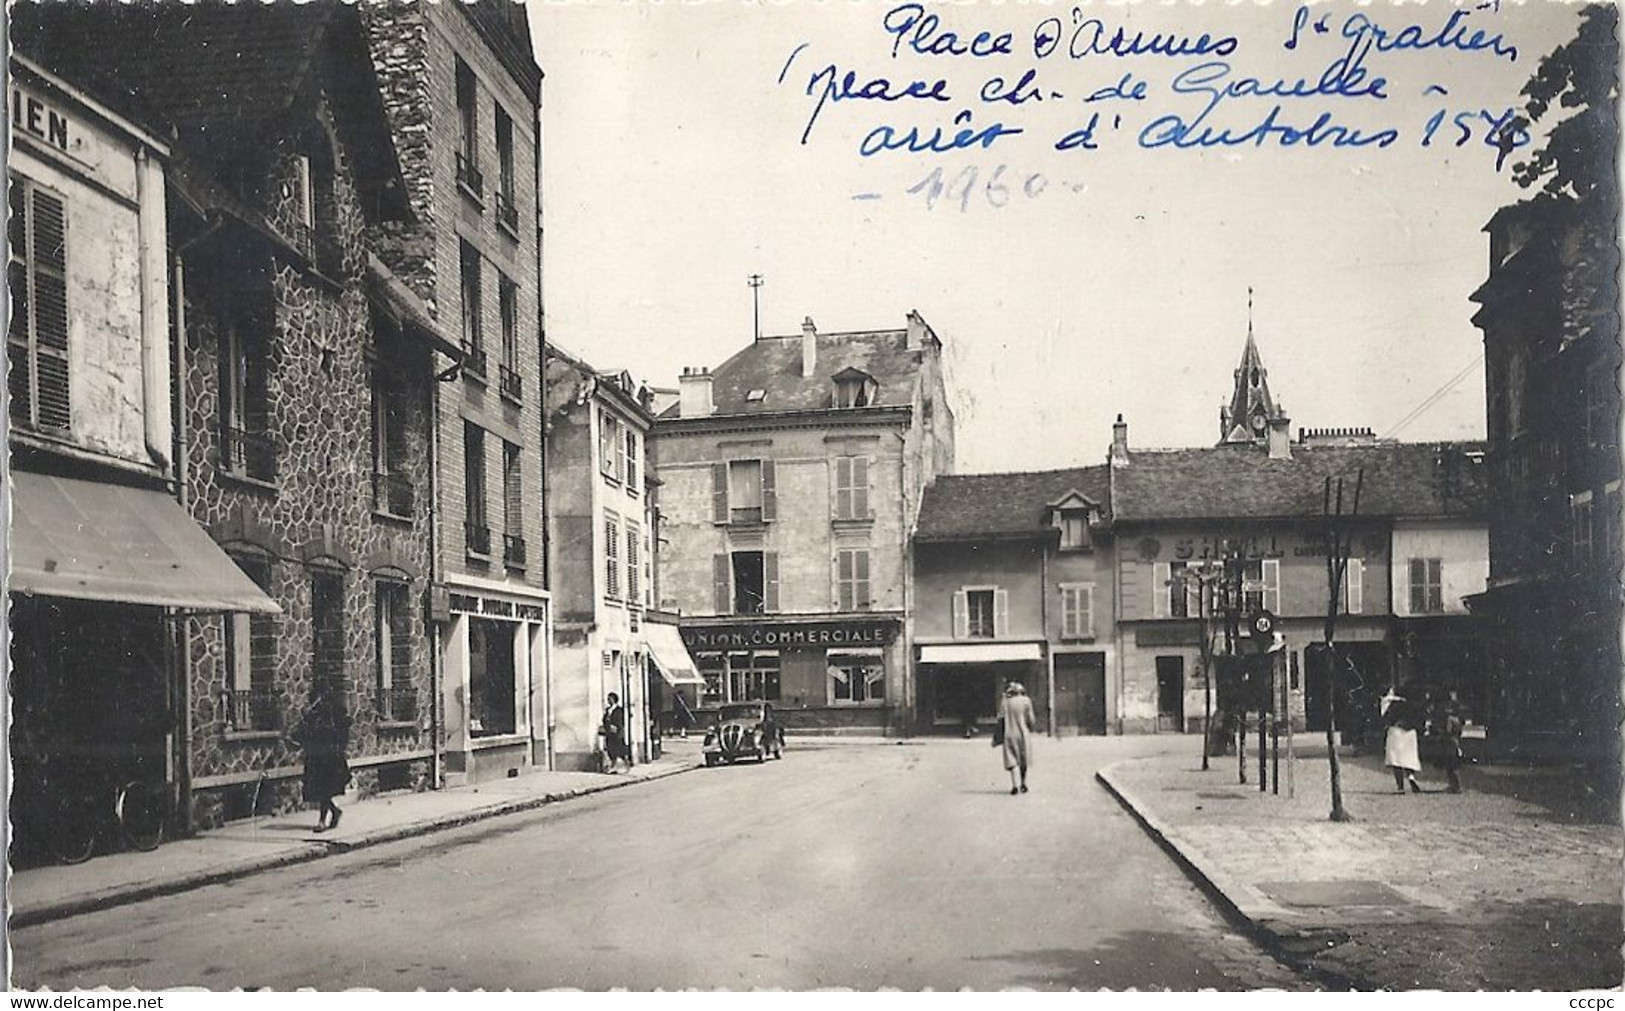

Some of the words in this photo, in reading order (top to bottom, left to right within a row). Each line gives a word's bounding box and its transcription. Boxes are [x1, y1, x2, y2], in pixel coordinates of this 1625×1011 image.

[884, 3, 1012, 58] Place
[1084, 73, 1147, 102] de
[1171, 58, 1388, 122] Gaulle
[1174, 536, 1284, 560] SHLL
[686, 631, 743, 647] UNION
[750, 627, 885, 646] COMMERCIALE
